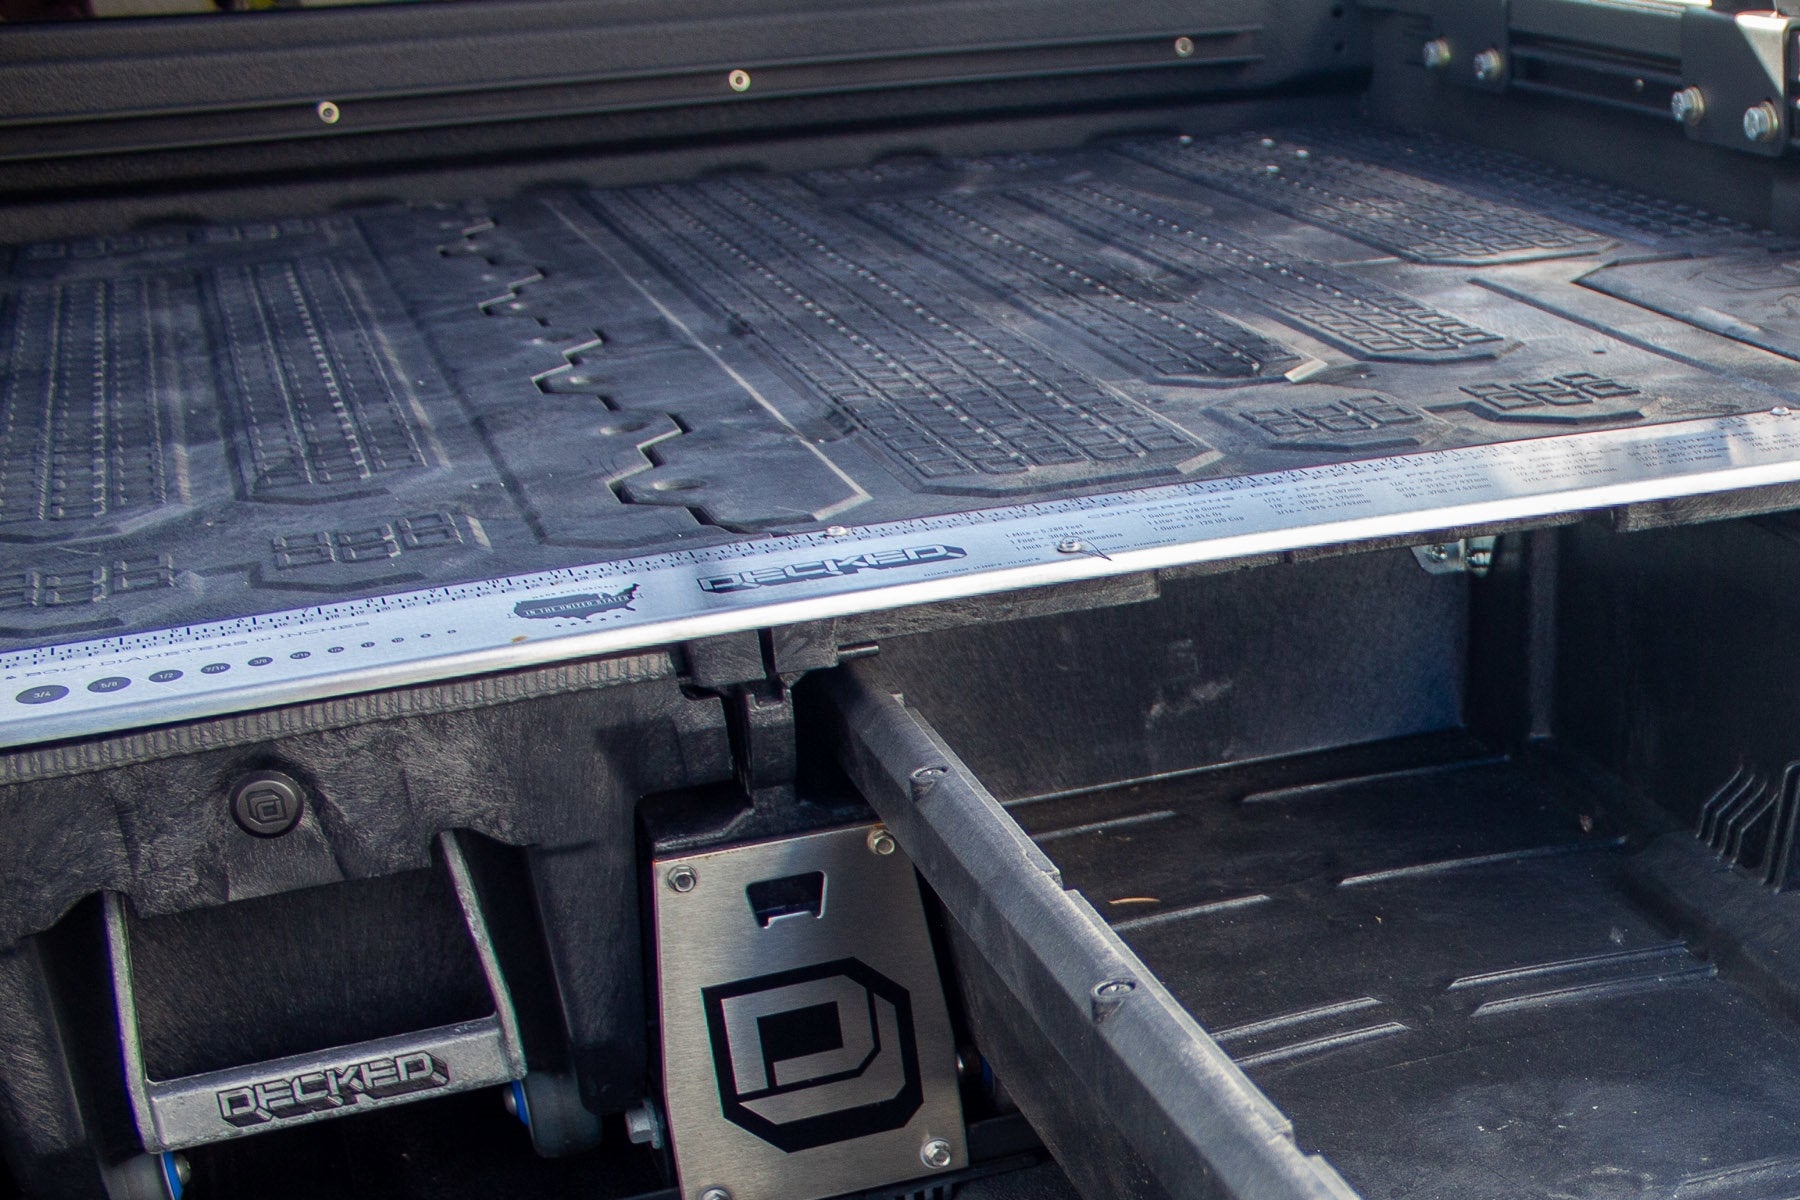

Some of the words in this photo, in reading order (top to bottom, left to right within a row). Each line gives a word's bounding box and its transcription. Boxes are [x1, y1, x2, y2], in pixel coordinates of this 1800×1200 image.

[696, 543, 967, 594] DECKED
[33, 690, 51, 698] 3/4
[101, 681, 118, 689] 5/8
[160, 672, 174, 680] 1/2
[216, 1049, 449, 1128] DECKED
